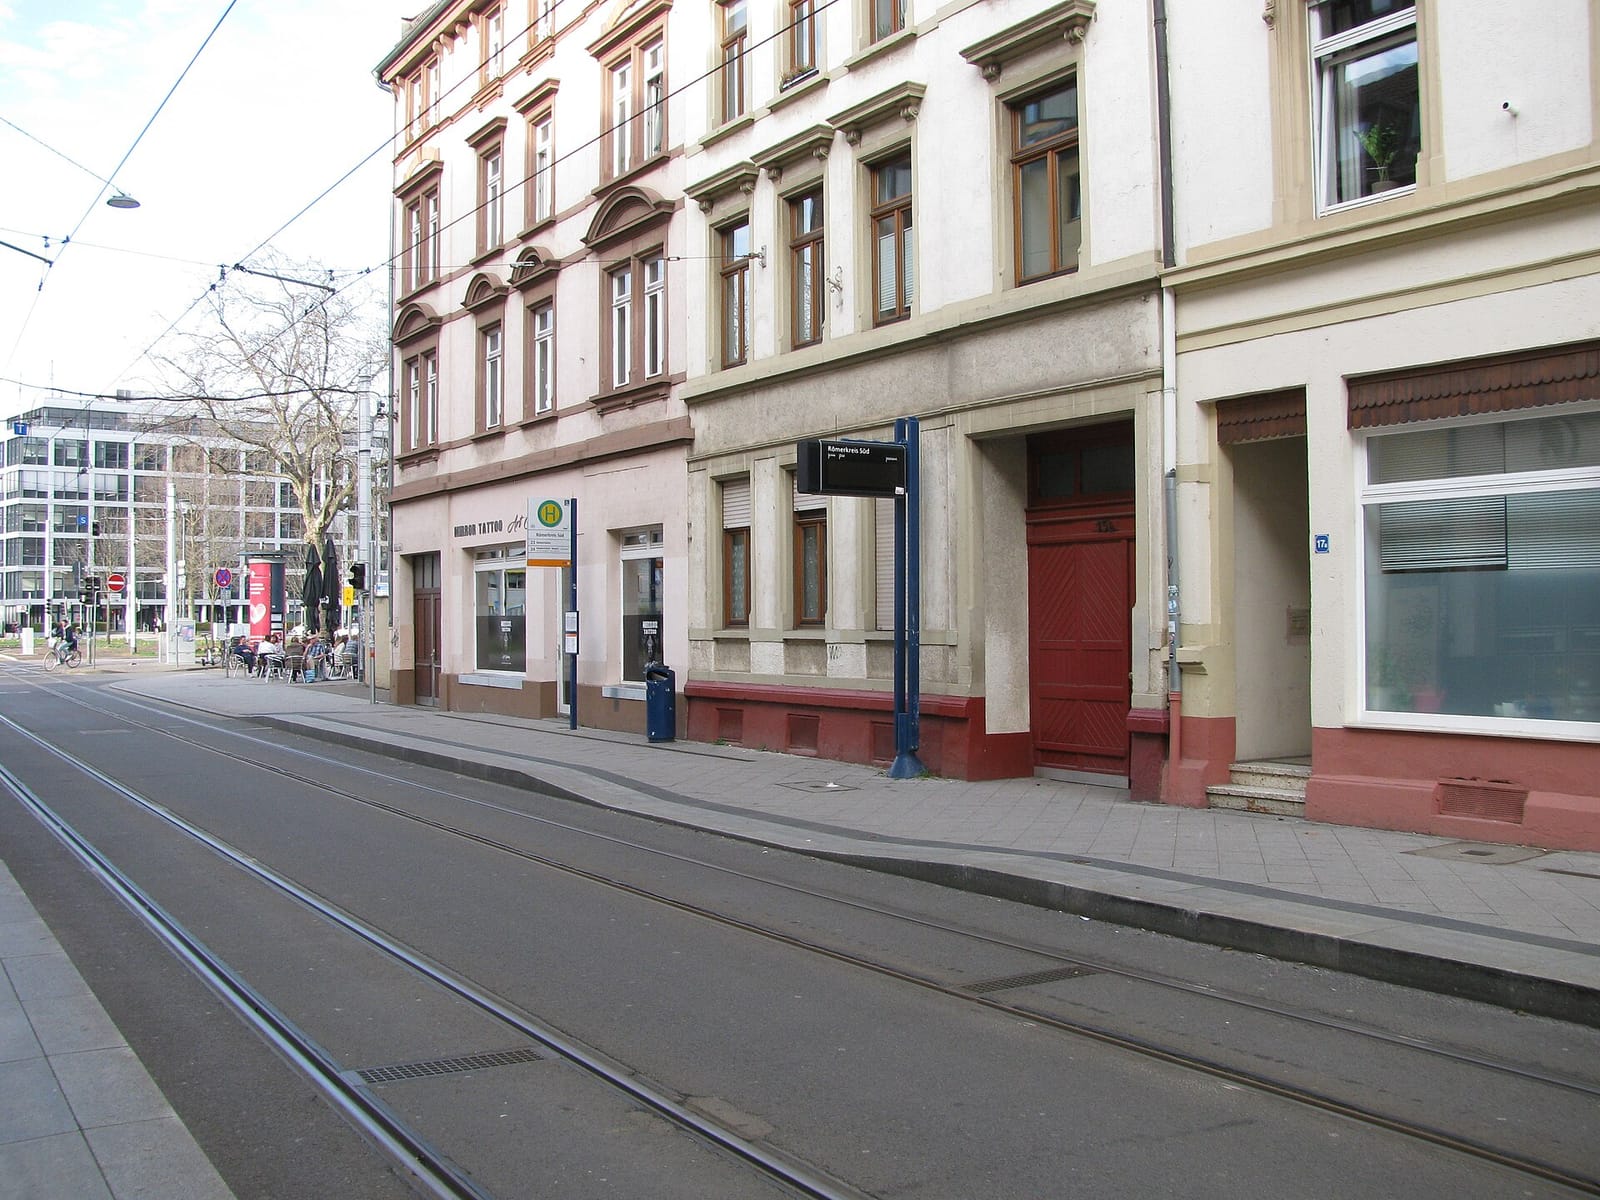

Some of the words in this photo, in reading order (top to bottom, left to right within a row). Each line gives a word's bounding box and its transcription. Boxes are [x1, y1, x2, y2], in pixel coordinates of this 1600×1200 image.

[827, 445, 859, 454] Römerkreis
[859, 447, 870, 455] Süd
[545, 506, 556, 521] H
[478, 519, 503, 535] TATTOO
